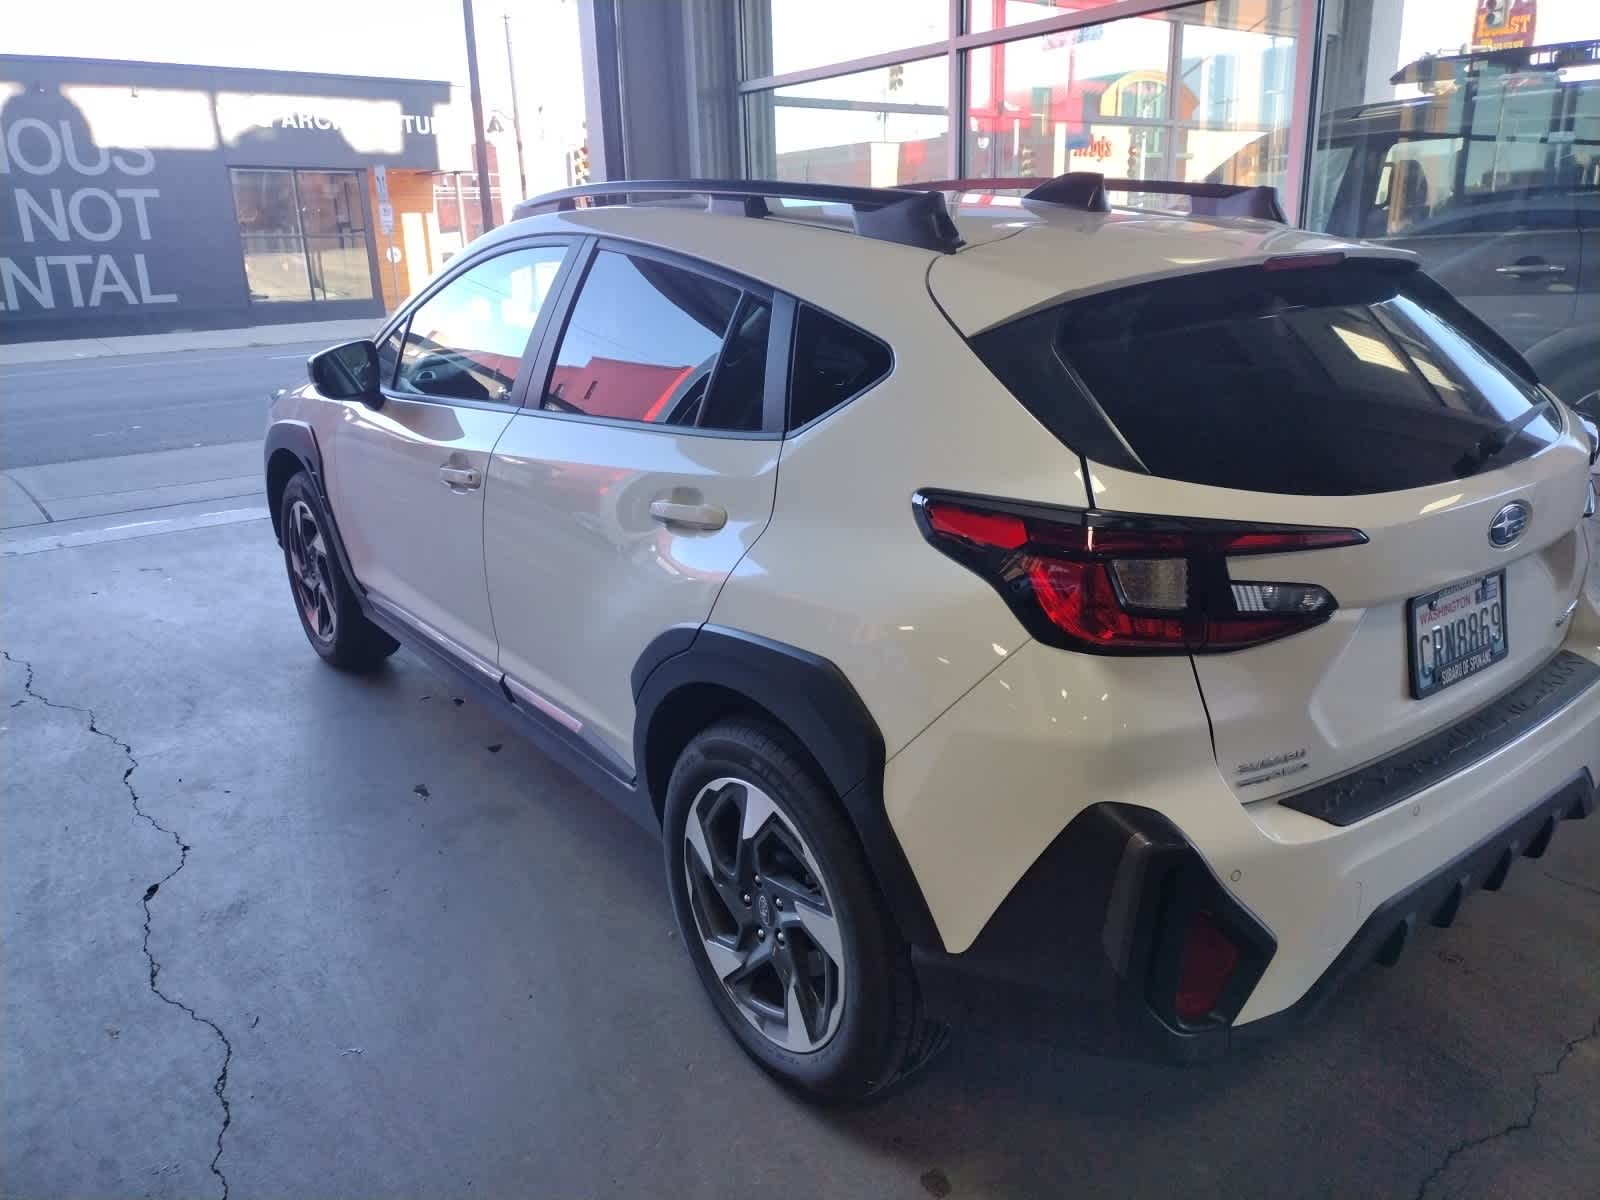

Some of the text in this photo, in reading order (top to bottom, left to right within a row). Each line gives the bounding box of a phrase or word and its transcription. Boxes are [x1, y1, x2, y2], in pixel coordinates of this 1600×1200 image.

[14, 187, 160, 243] NOT
[0, 254, 178, 311] NTAL
[1420, 593, 1471, 625] WASHINGTON
[1420, 602, 1502, 679] CRN8869
